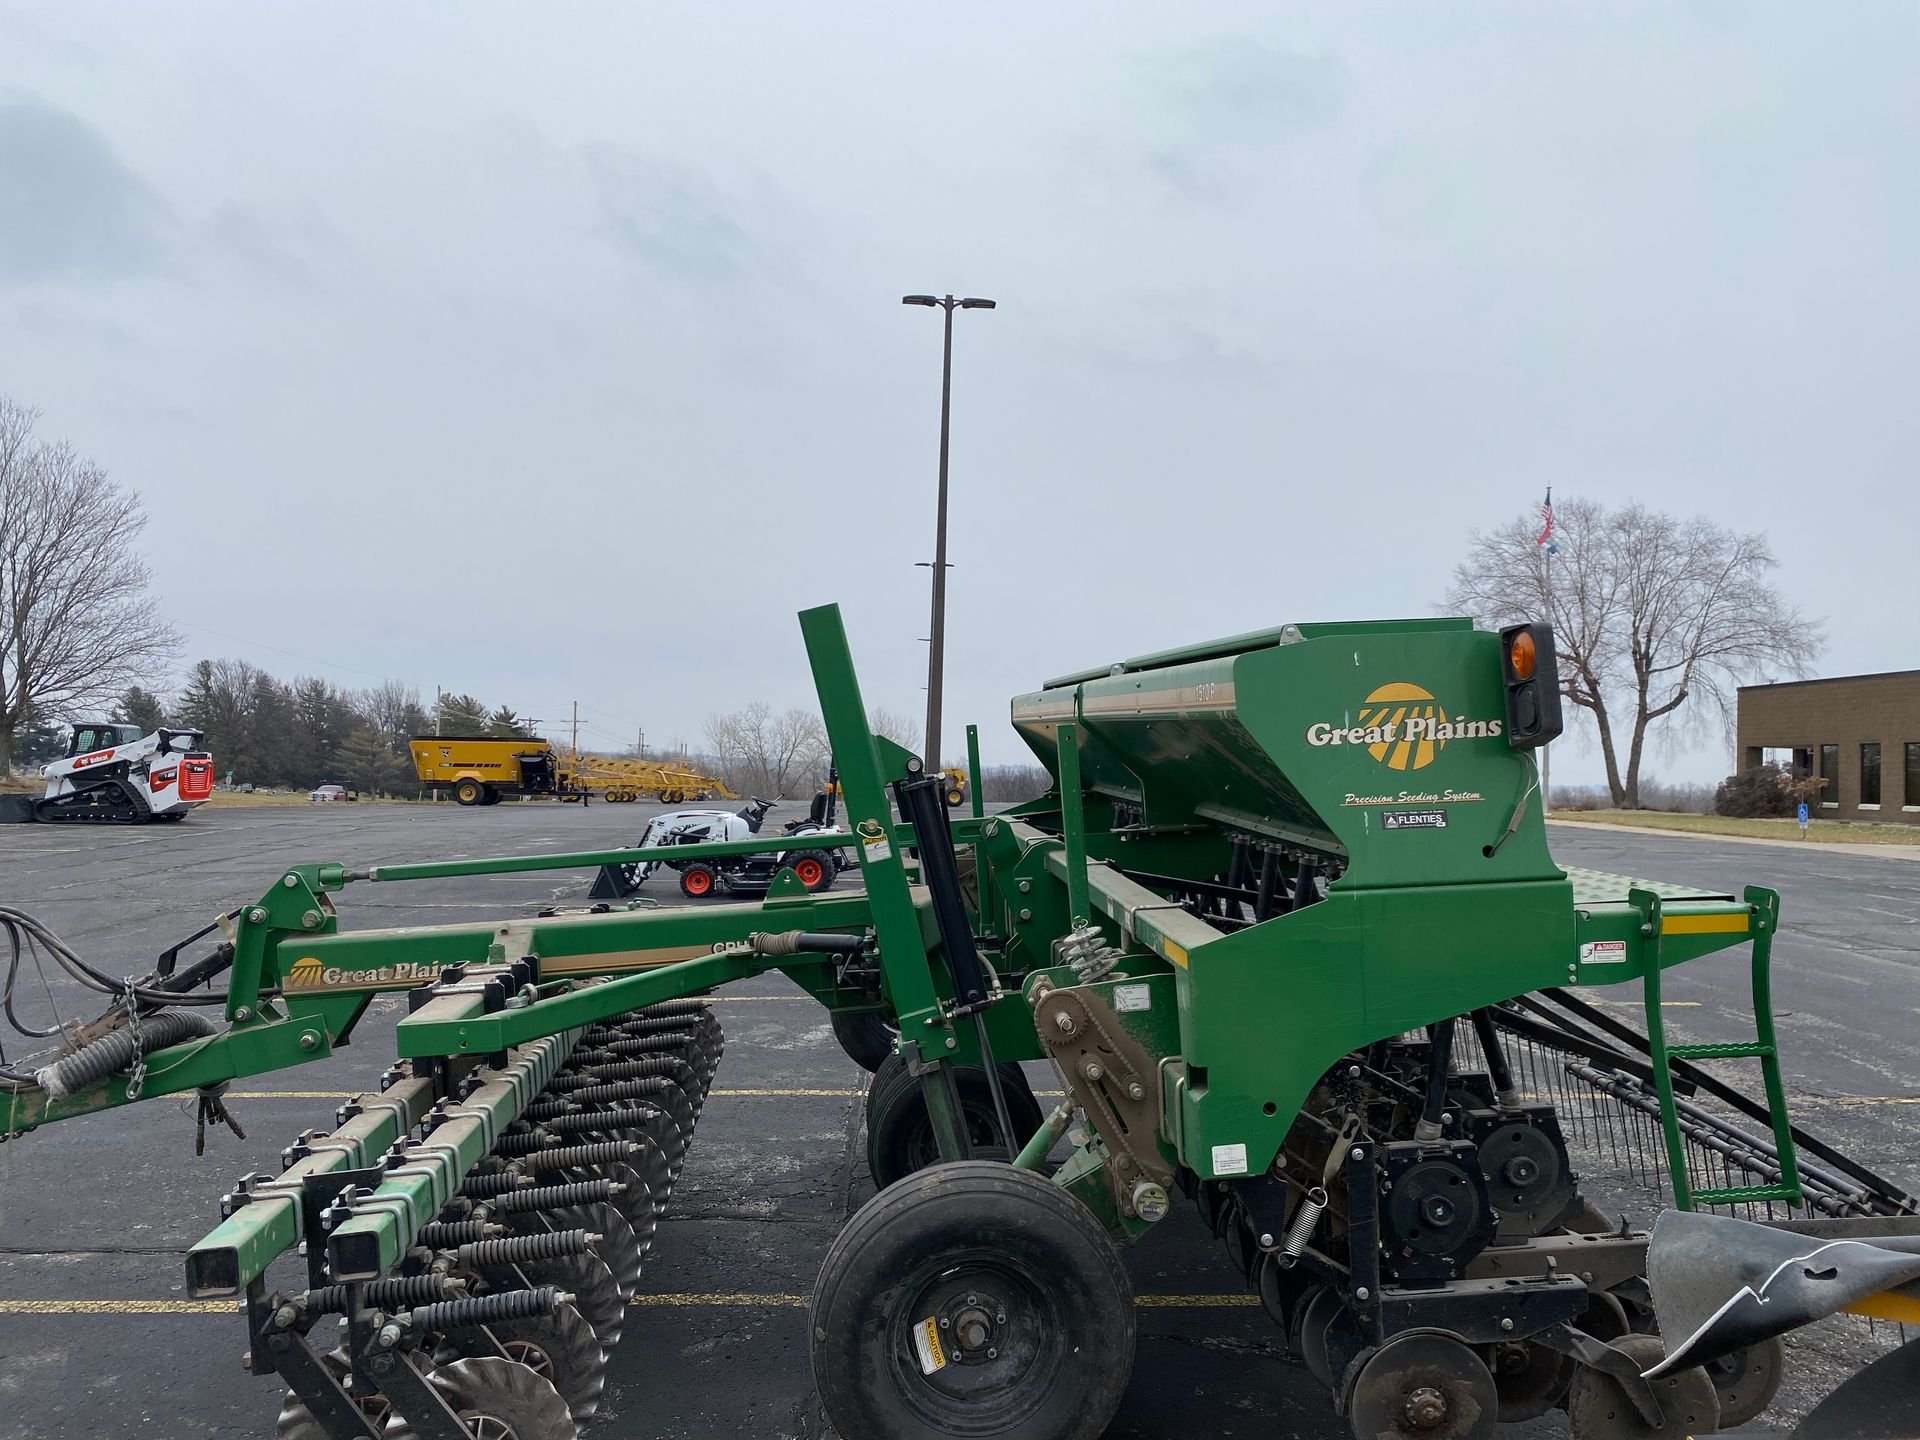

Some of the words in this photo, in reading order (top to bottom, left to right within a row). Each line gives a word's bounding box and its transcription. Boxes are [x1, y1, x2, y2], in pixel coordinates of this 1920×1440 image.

[1307, 721, 1397, 746] Great
[1403, 716, 1502, 742] Plains
[90, 754, 108, 764] Bobcat
[1345, 793, 1393, 804] Precision
[1398, 791, 1438, 803] Seeding
[1443, 789, 1480, 802] System
[1398, 814, 1443, 824] FLENTIES
[322, 966, 388, 985] Great
[393, 960, 454, 980] Plain
[928, 1330, 943, 1365] CAUTION
